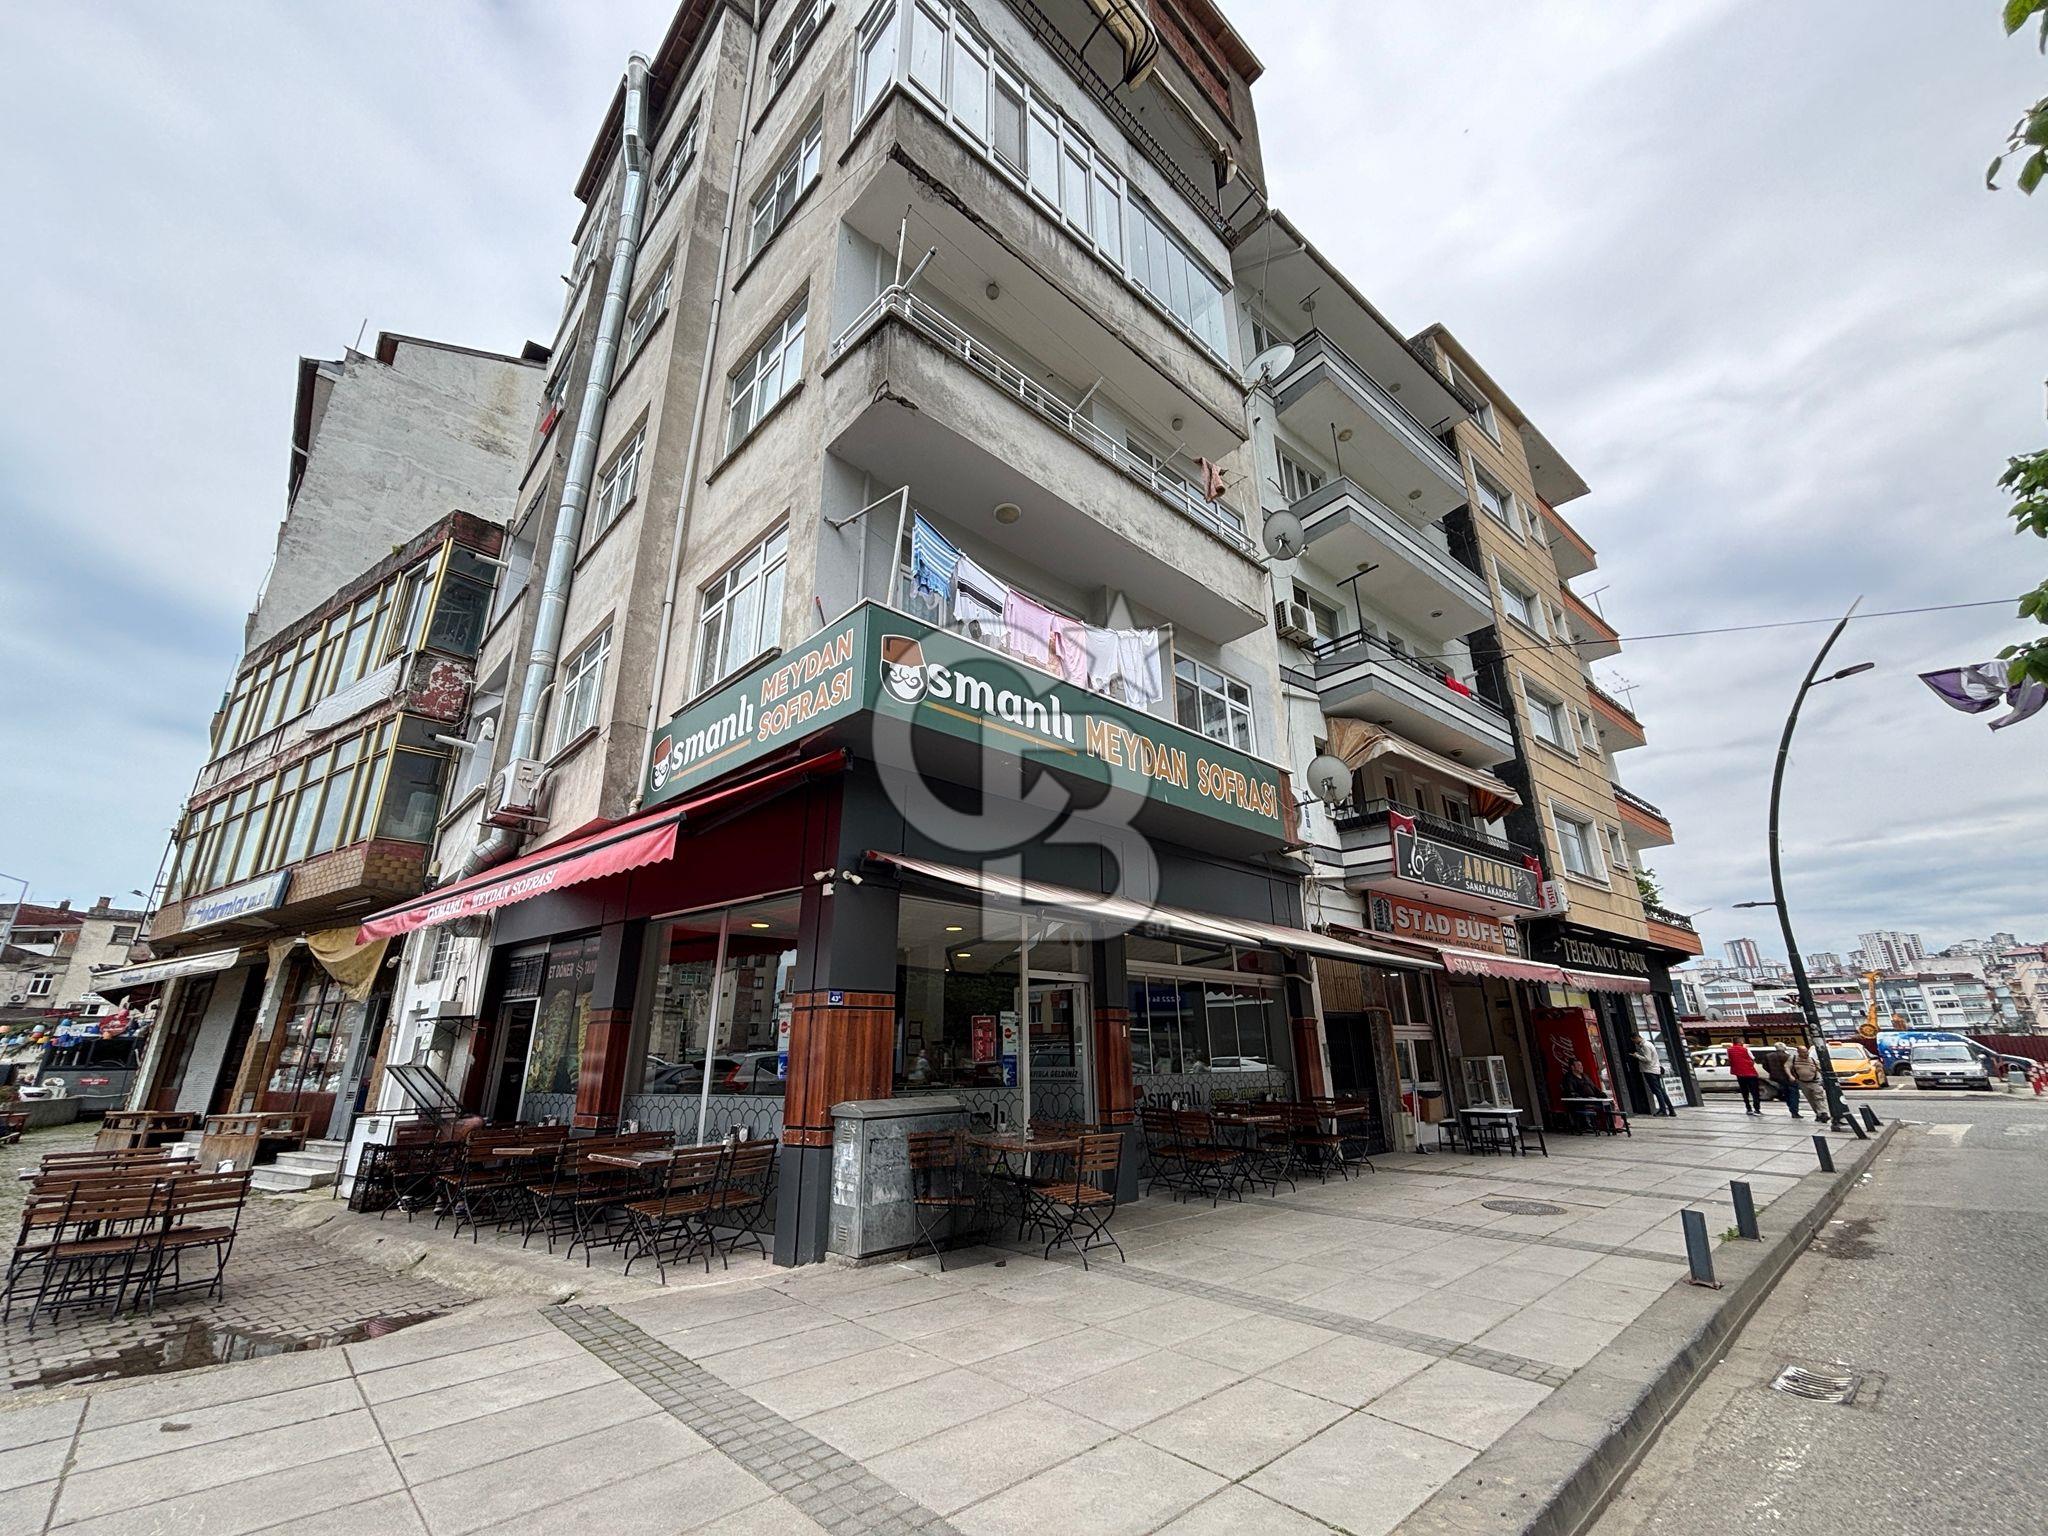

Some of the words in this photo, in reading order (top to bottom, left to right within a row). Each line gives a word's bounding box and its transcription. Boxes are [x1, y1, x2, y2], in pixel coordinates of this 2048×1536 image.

[760, 628, 854, 707] MEYDAN
[757, 667, 854, 742] SOFRASI
[1085, 714, 1189, 789] MEYDAN
[1196, 758, 1279, 820] SOFRASI
[471, 888, 511, 909] MEYDAN
[511, 869, 558, 897] SOFRASI
[1464, 855, 1517, 891] ARMONİ
[1466, 882, 1487, 893] SANAT
[1487, 886, 1519, 901] AKADEMİSİ
[1395, 905, 1451, 936] STAD
[1455, 914, 1502, 945] BÜFE
[548, 964, 556, 979] ET
[556, 962, 574, 978] DÖNER
[1561, 937, 1618, 969] TELEFONCU
[1618, 950, 1650, 973] FARUK
